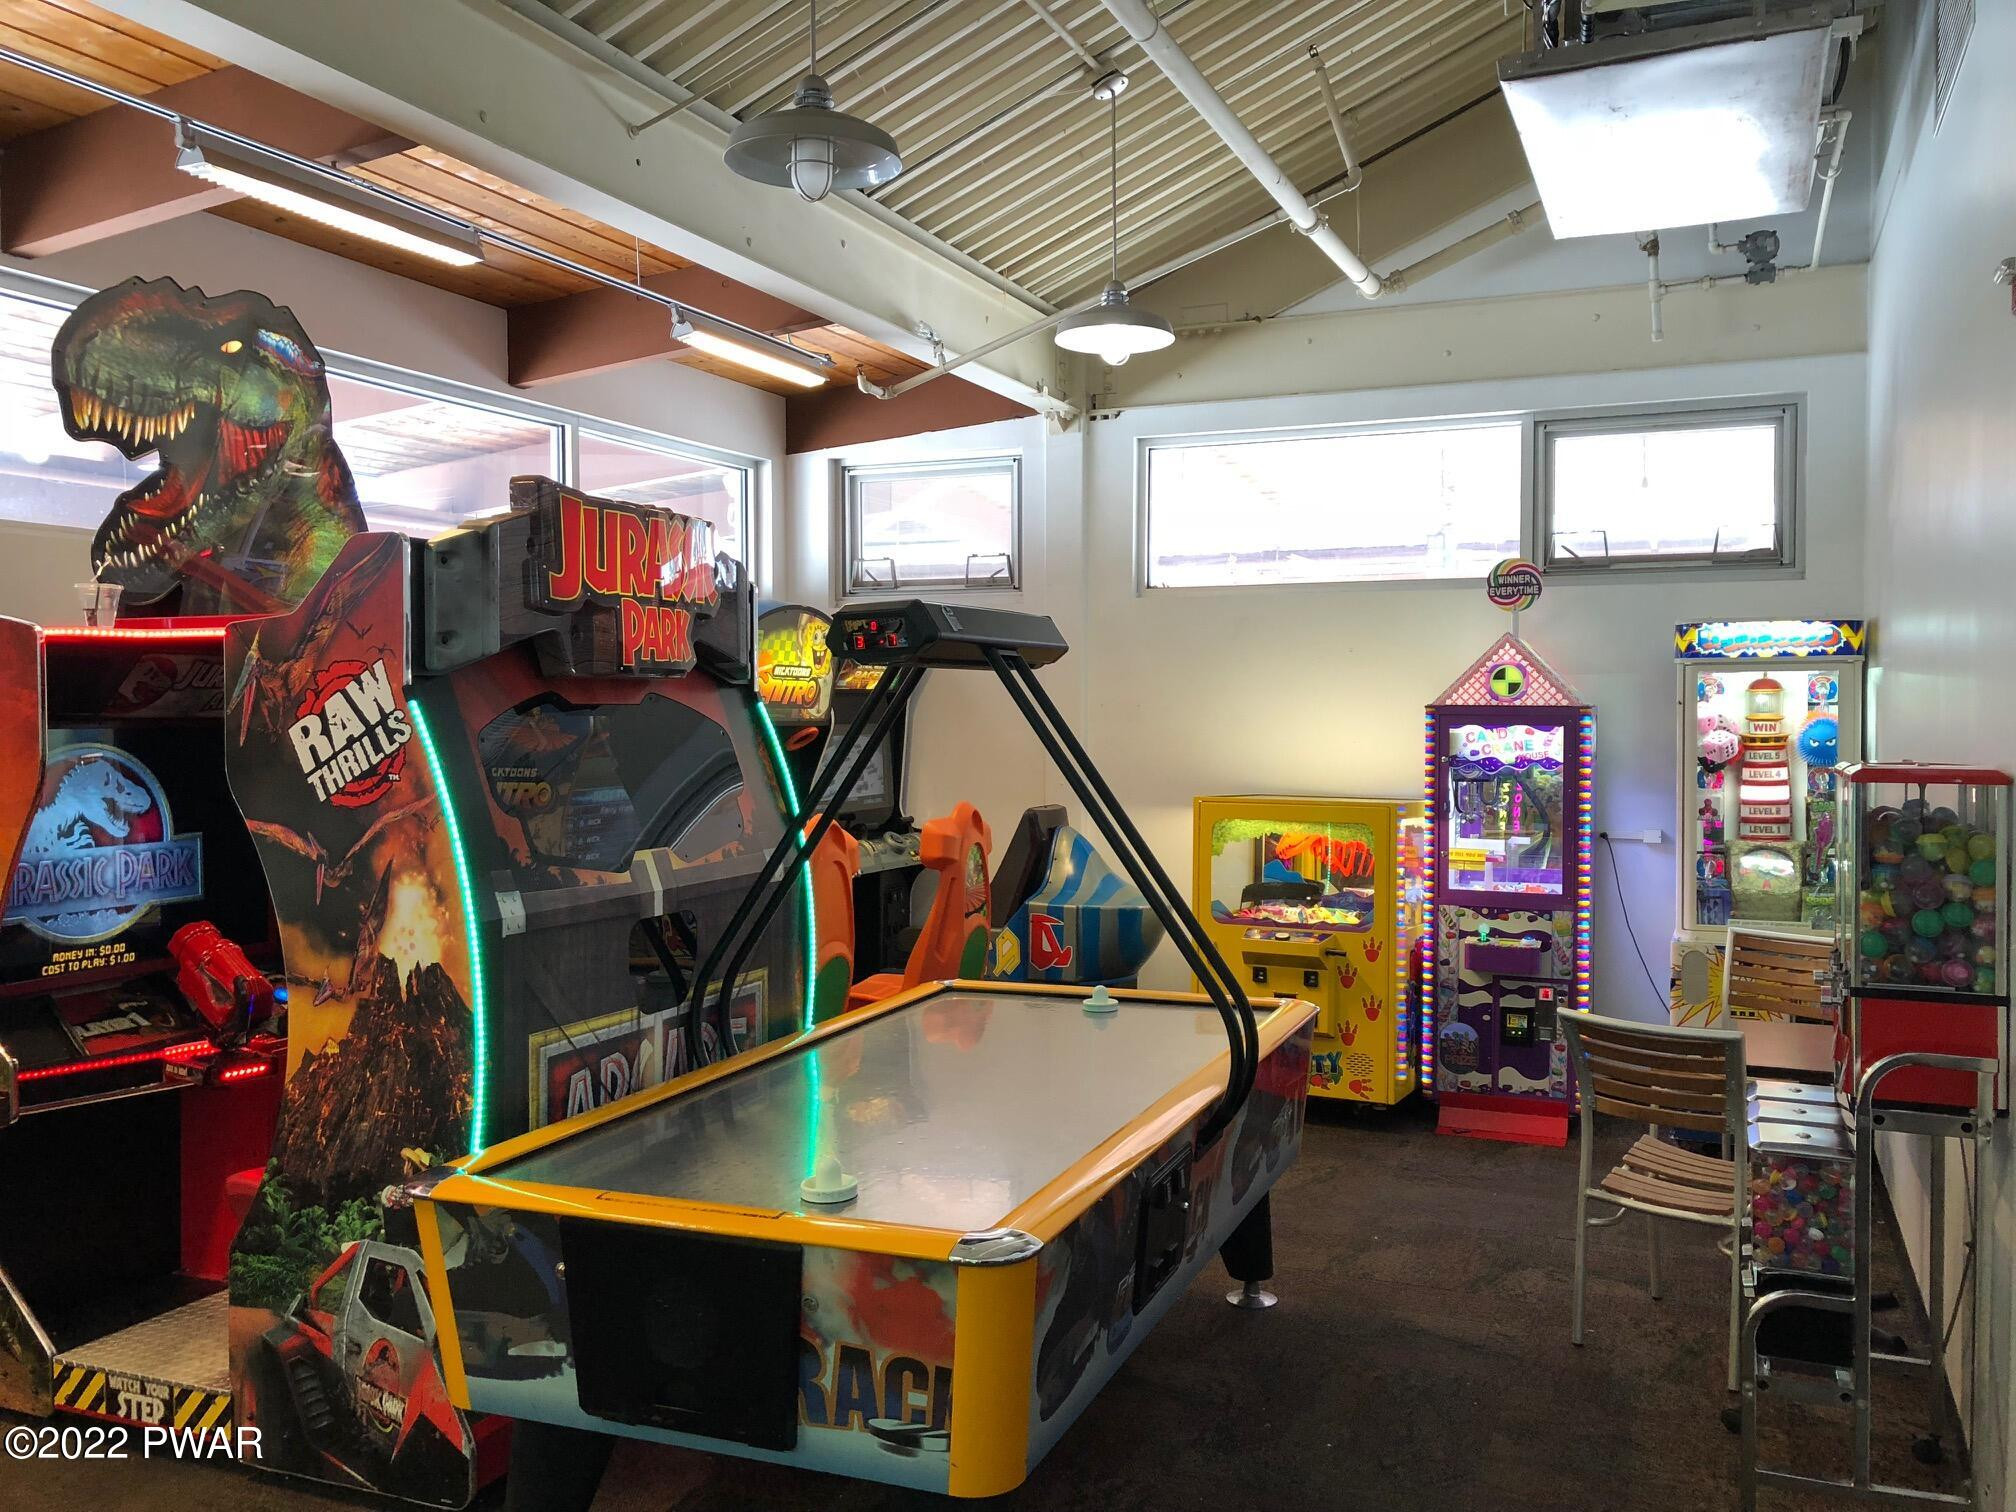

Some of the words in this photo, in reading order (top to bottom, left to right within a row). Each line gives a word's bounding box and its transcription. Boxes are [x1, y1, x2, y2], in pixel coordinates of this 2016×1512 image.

[1498, 575, 1531, 584] WINNER
[1489, 585, 1540, 596] EVERYTIME
[621, 598, 692, 666] PARK
[759, 675, 817, 704] NITRO
[288, 659, 396, 774] RAW
[1753, 723, 1777, 733] WIN
[307, 710, 412, 802] THRILLS
[1481, 740, 1534, 755] CRANE
[1749, 752, 1773, 760] LEVEL
[1775, 752, 1780, 760] 5
[1749, 770, 1774, 778] LEVEL
[1775, 770, 1781, 778] 4
[1776, 807, 1781, 815] 2
[9, 856, 111, 906] RASSIC
[114, 849, 195, 898] PARK
[53, 950, 83, 962] MONEY
[85, 948, 97, 957] IN:
[99, 943, 126, 955] $0.00
[41, 964, 65, 976] COST
[68, 962, 79, 972] TO
[81, 958, 108, 969] PLAY:
[109, 1375, 140, 1393] WATCH
[144, 1381, 170, 1399] YOUR
[117, 1393, 165, 1425] STEP
